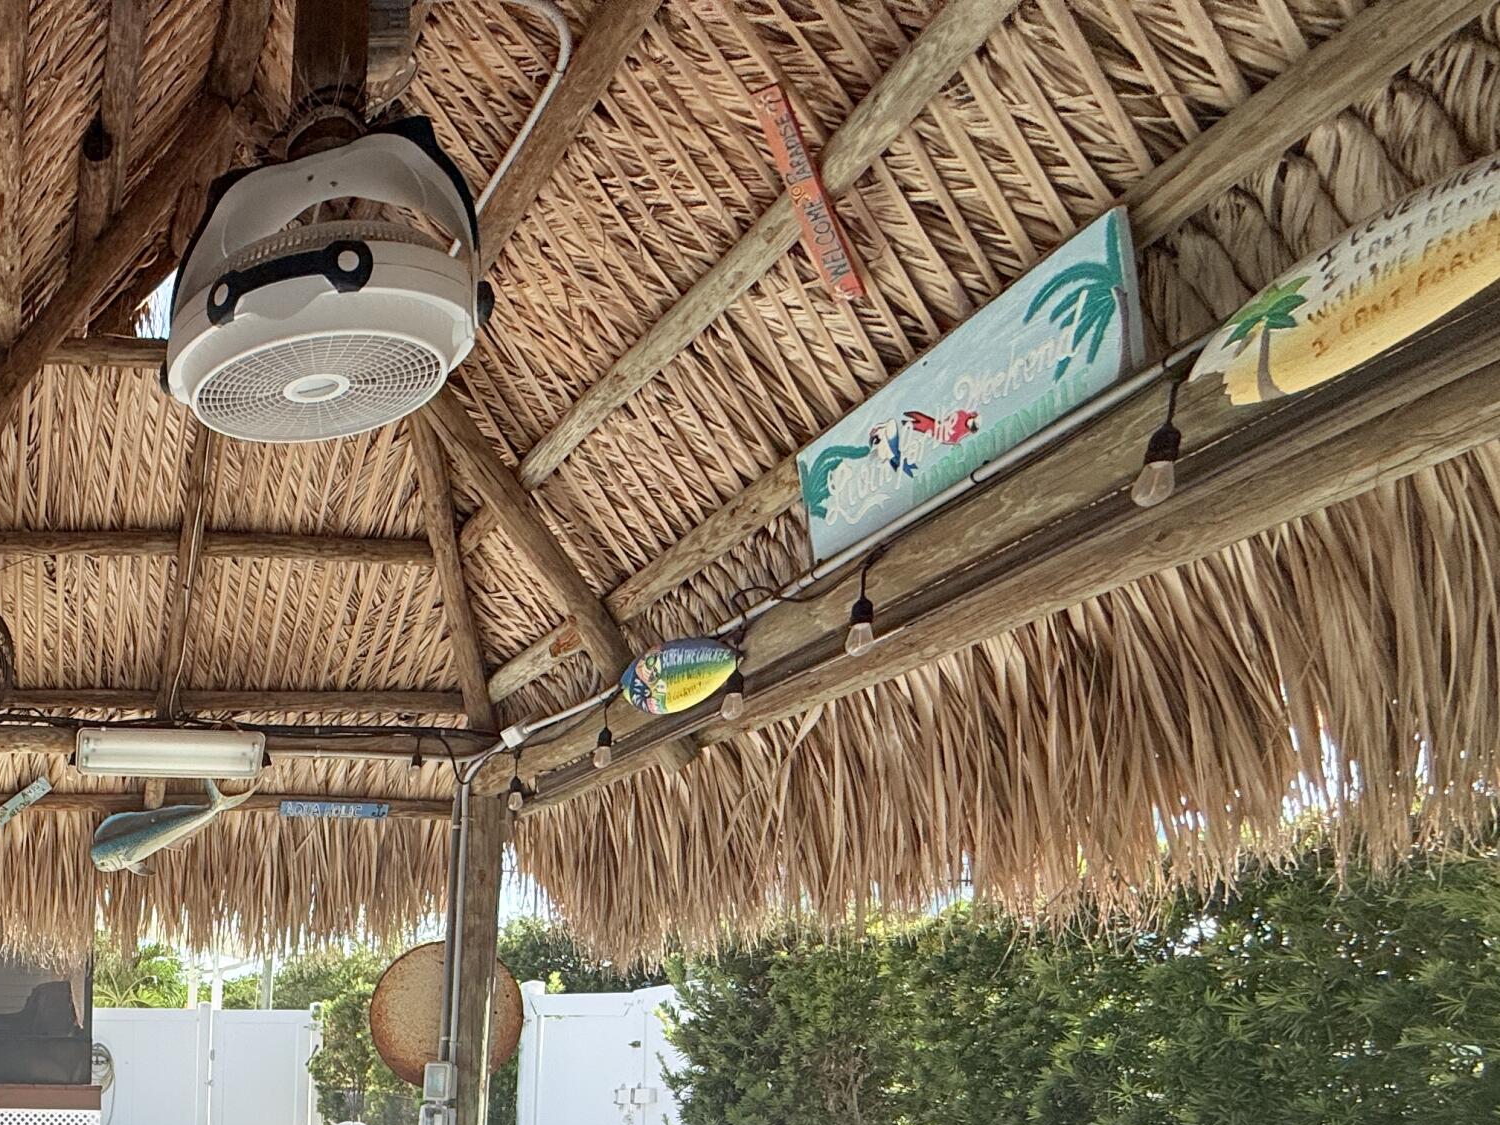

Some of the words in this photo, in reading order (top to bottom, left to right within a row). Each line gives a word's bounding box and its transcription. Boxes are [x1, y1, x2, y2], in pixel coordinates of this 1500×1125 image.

[775, 113, 813, 186] PARADISE
[803, 192, 850, 284] WELCOME
[1317, 243, 1341, 273] I
[1351, 192, 1421, 247] LOVE
[1428, 168, 1479, 201] THE
[954, 290, 1088, 411] Weekend
[912, 367, 1090, 504] MARGARITAVILLE
